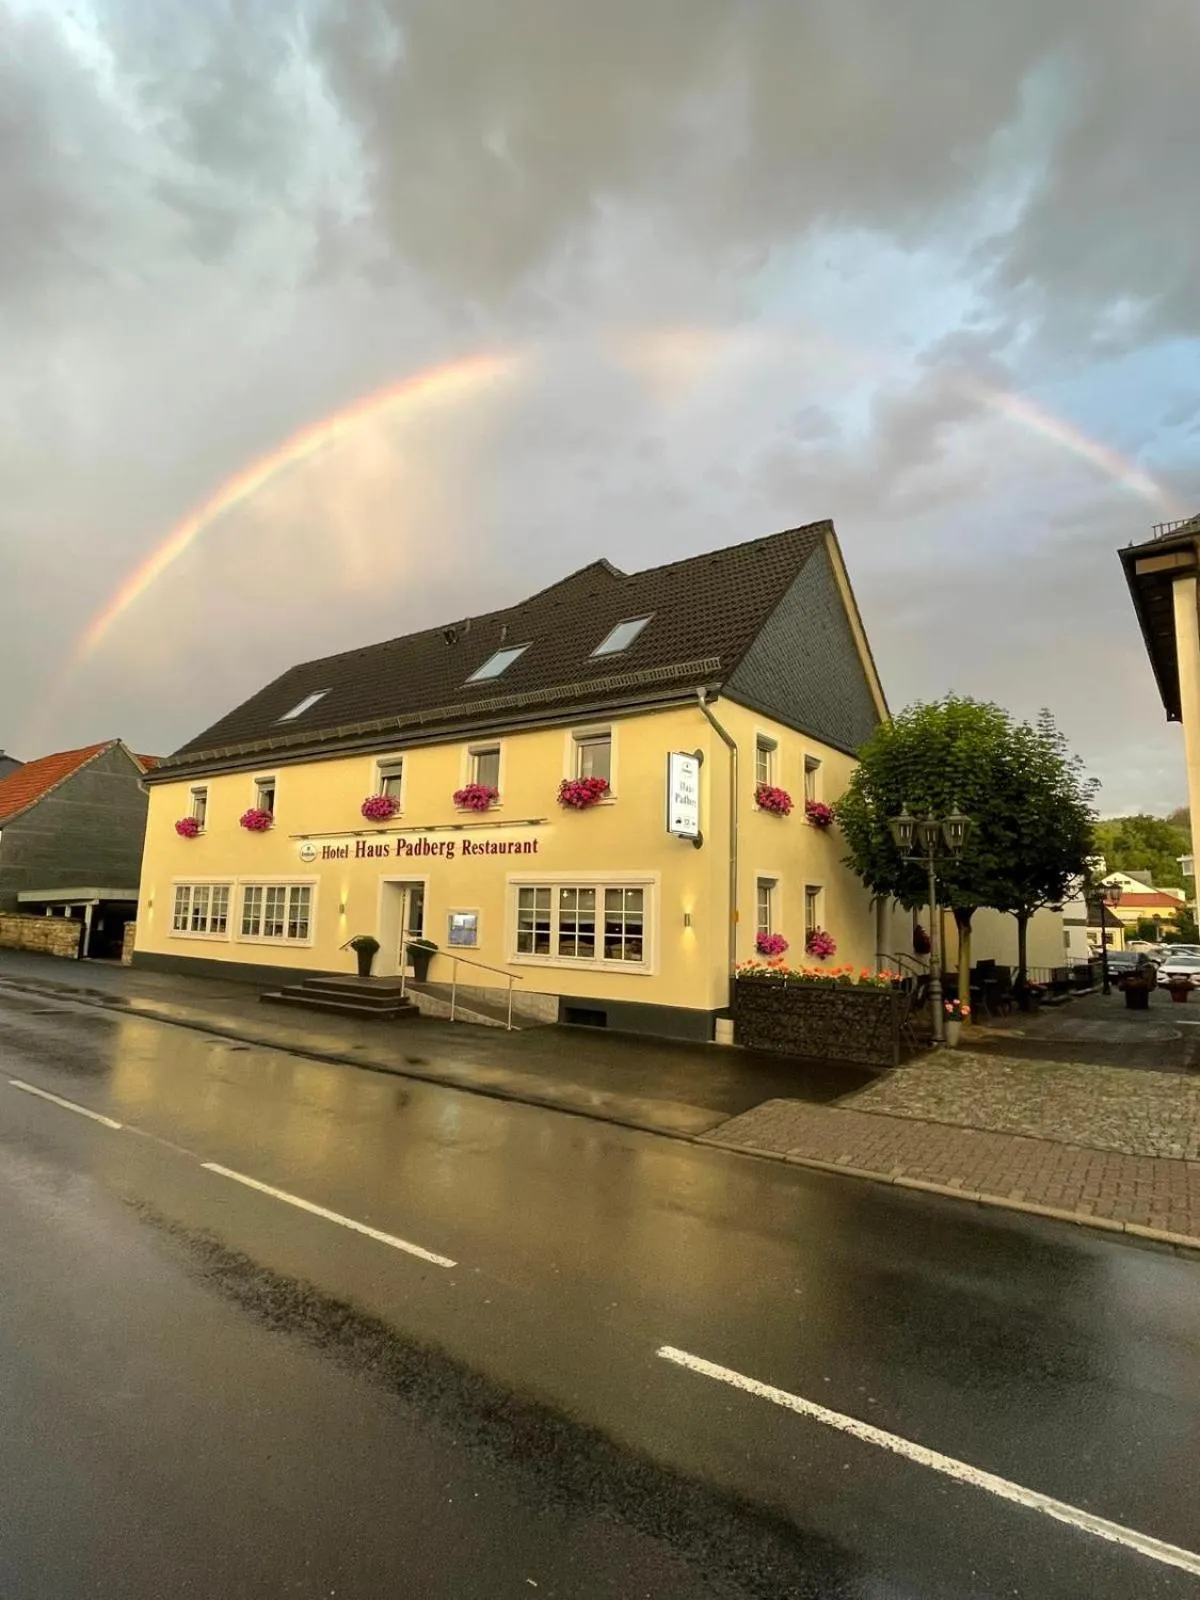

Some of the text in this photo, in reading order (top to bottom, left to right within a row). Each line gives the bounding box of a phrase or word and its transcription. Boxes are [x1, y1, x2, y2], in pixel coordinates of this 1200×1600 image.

[322, 837, 539, 860] Hotel Haus Padberg Restaurant
